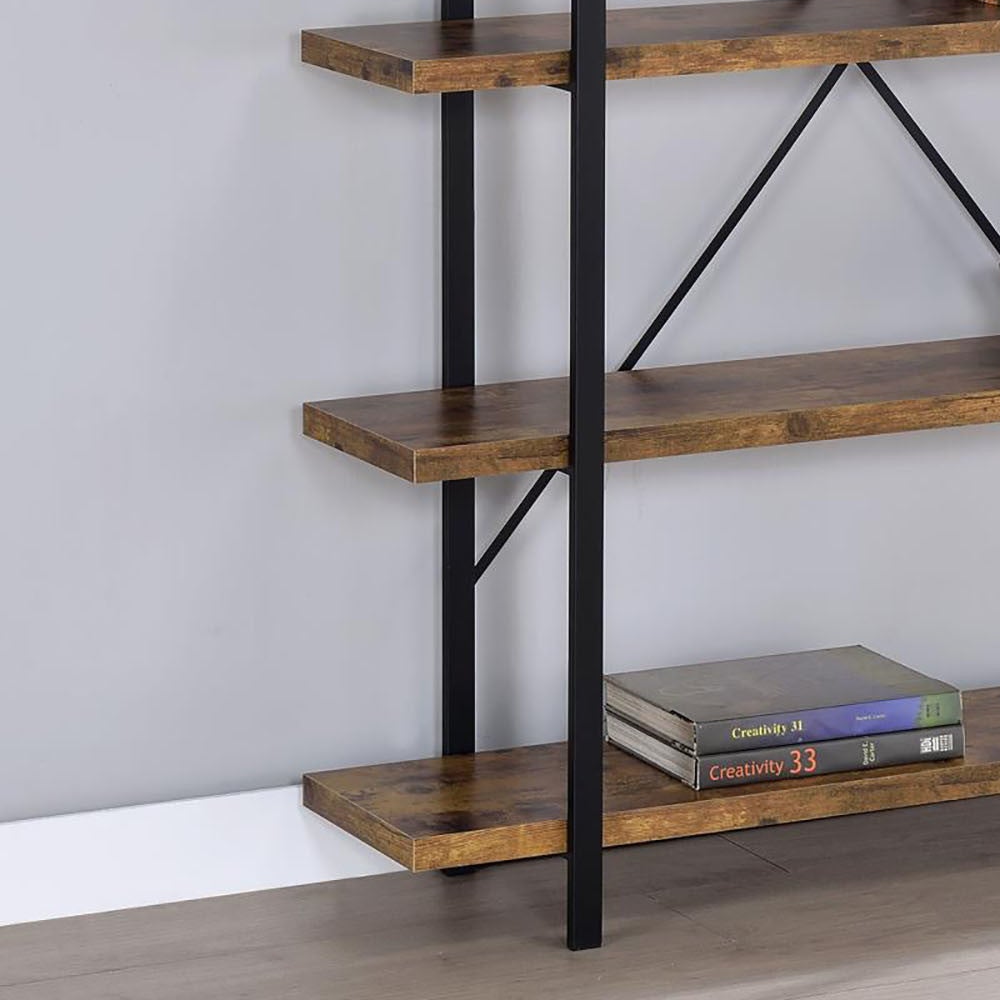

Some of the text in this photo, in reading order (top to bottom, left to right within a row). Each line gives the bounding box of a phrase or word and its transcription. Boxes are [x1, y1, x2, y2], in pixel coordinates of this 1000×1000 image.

[732, 723, 786, 738] Creativity
[709, 748, 816, 780] Creativity 33
